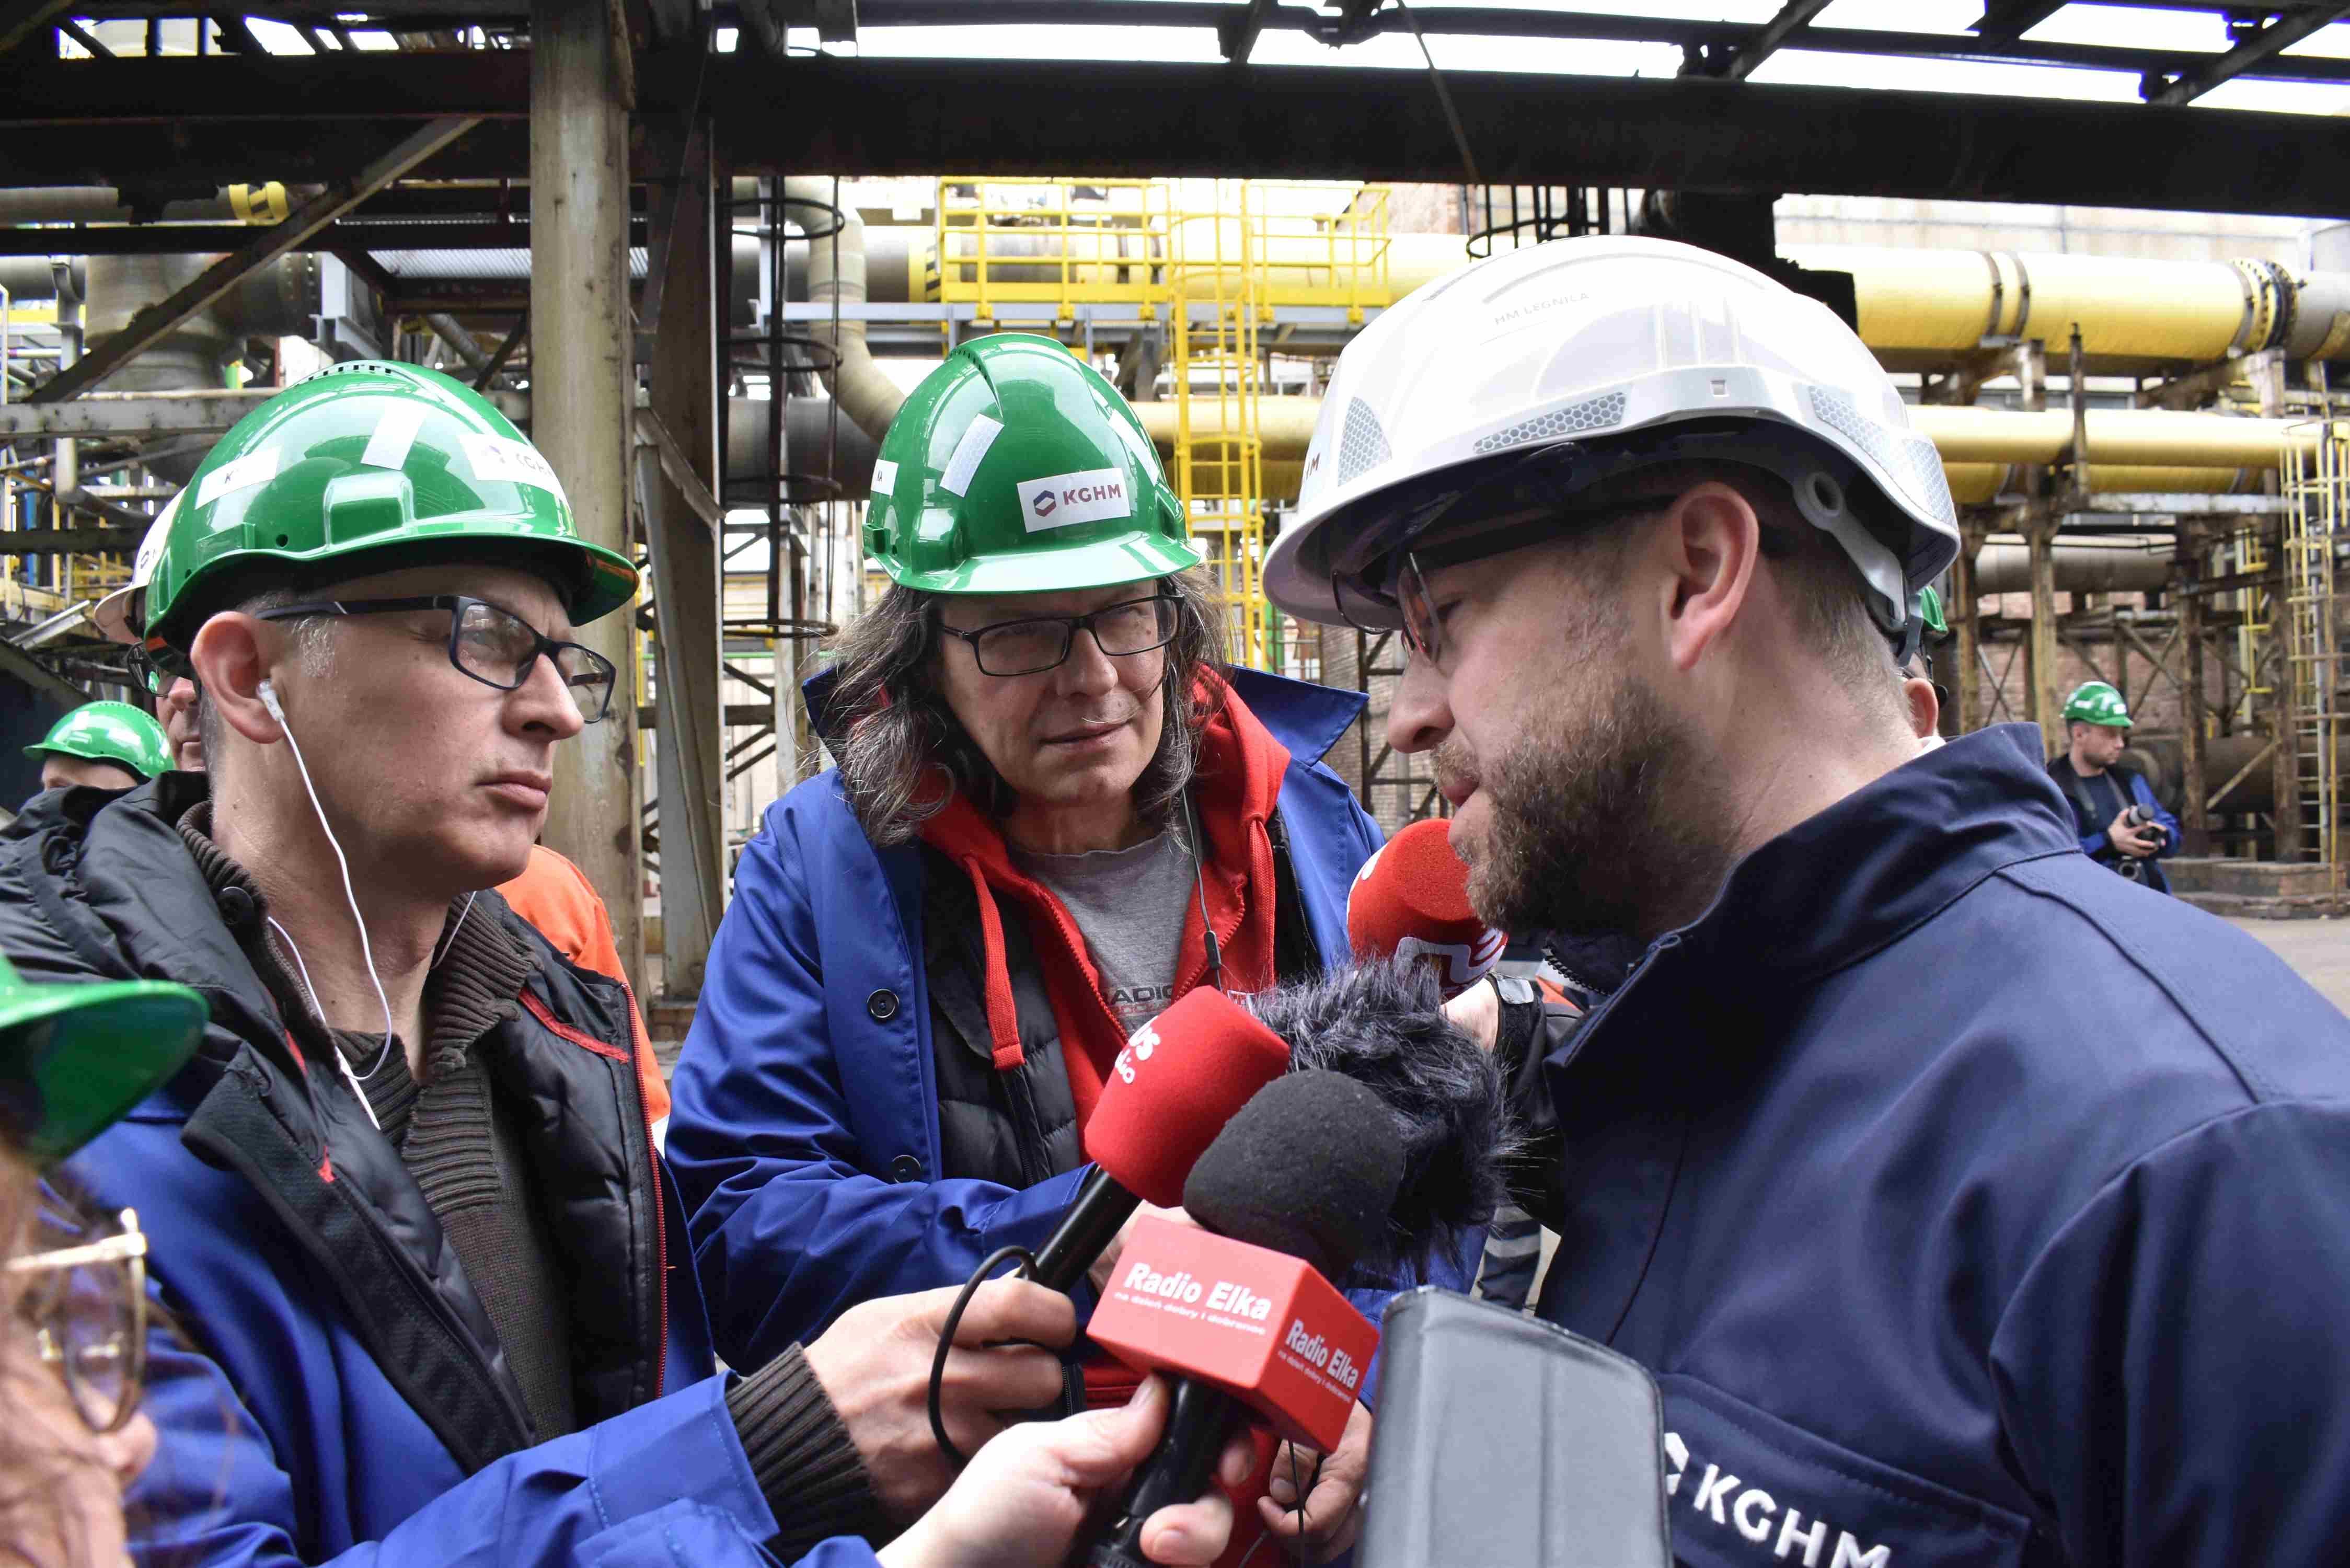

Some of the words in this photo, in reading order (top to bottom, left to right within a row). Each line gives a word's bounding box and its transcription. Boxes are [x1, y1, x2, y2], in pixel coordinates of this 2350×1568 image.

[1063, 483, 1122, 506] KGHM
[1124, 1262, 1202, 1303] Radio
[1205, 1281, 1272, 1320] Elka
[1285, 1318, 1329, 1368] Radio
[1327, 1347, 1359, 1390] Elka
[1693, 1463, 1892, 1568] KGHM
